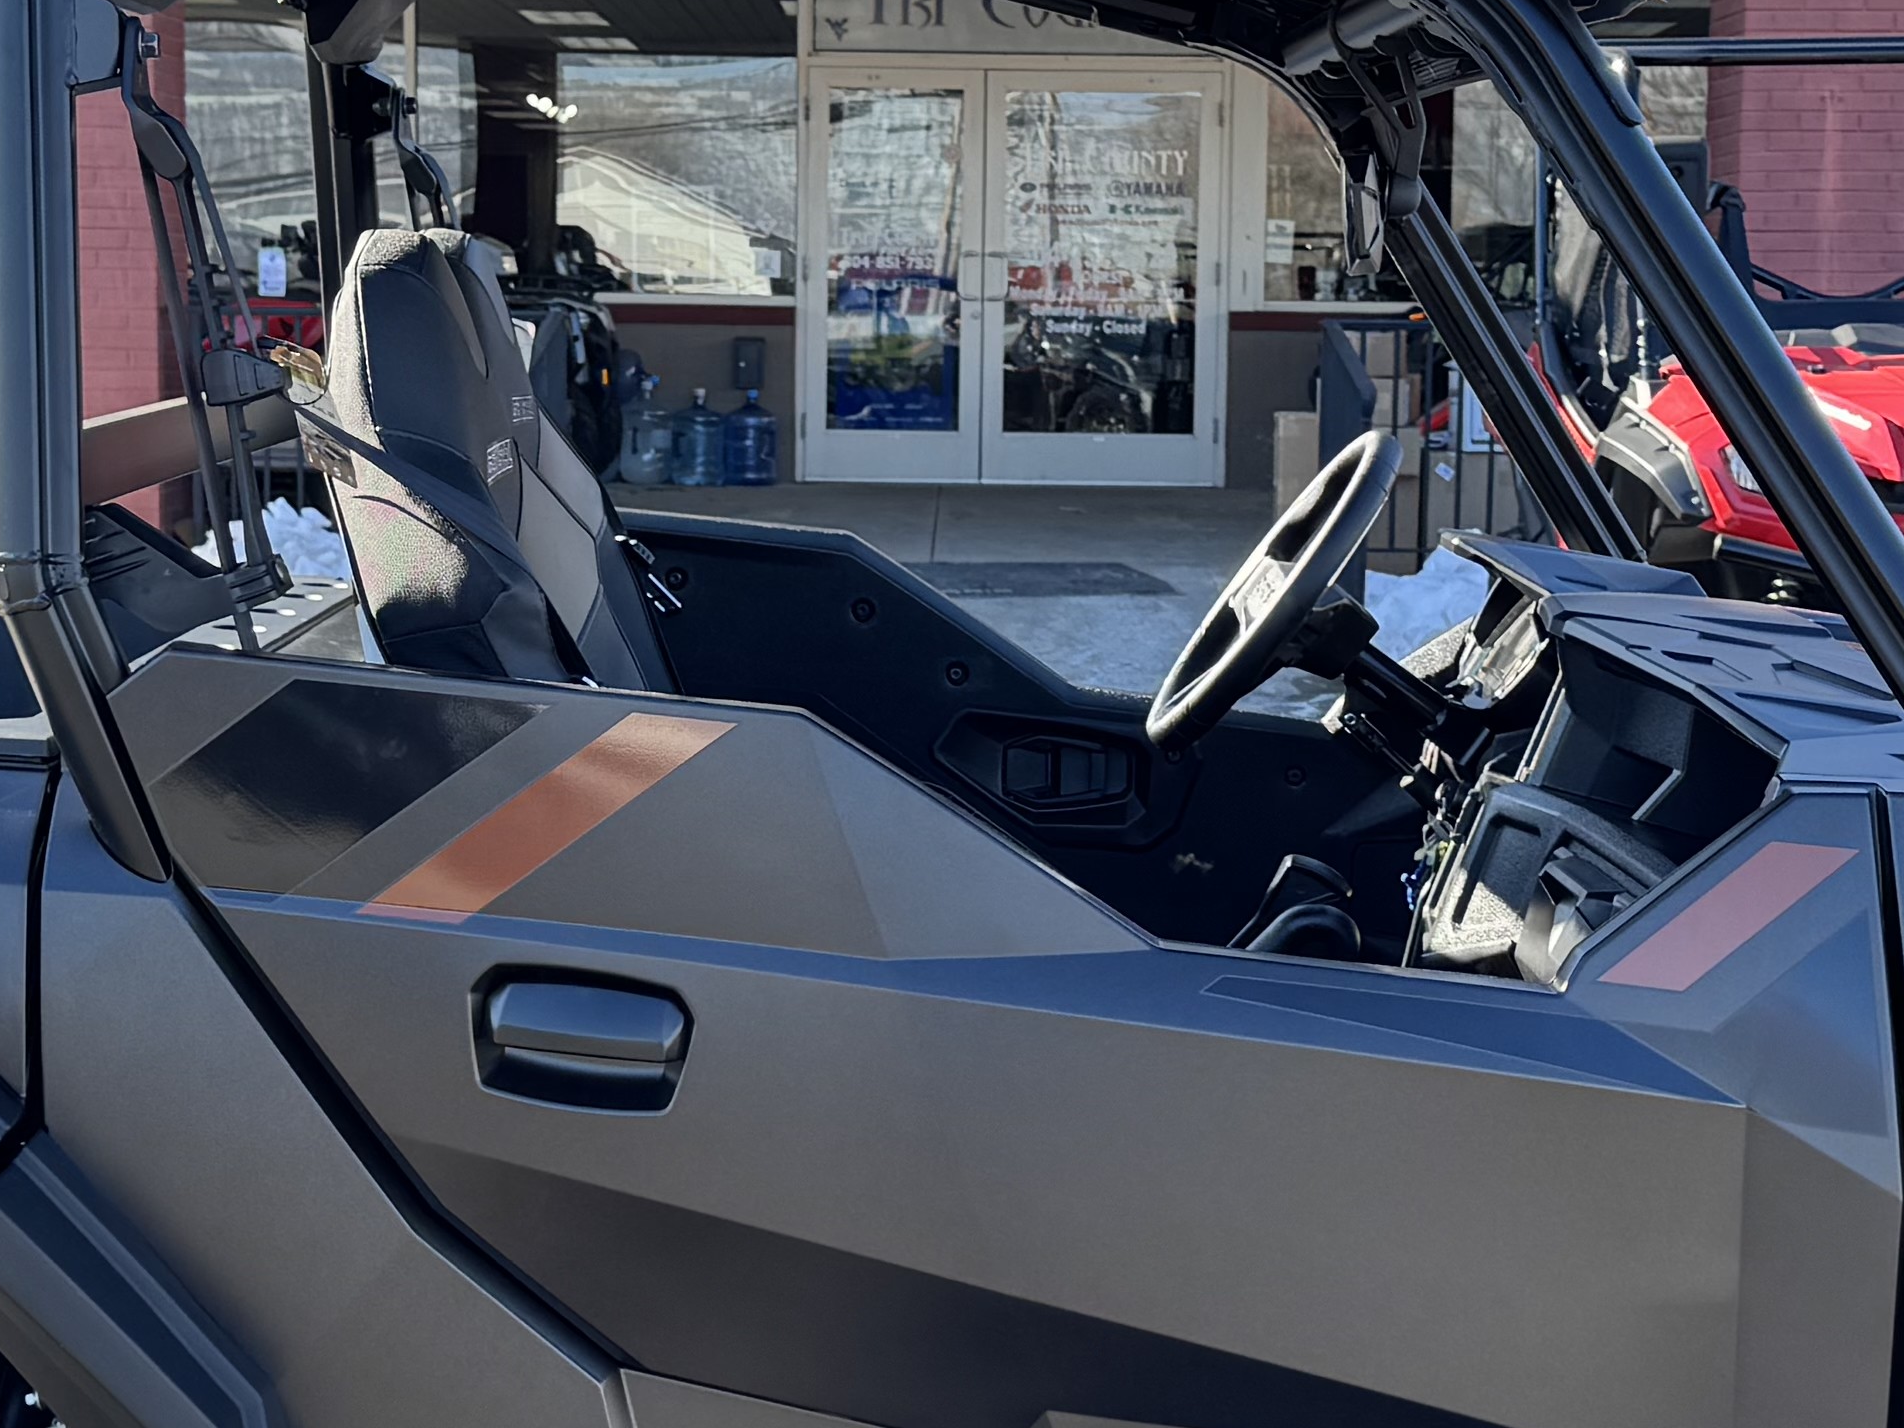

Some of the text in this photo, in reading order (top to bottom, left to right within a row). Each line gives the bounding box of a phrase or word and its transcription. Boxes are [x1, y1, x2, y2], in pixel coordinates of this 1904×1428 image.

[1035, 203, 1093, 215] HONDA
[1046, 319, 1093, 337] Sunday
[1102, 320, 1147, 335] Closed
